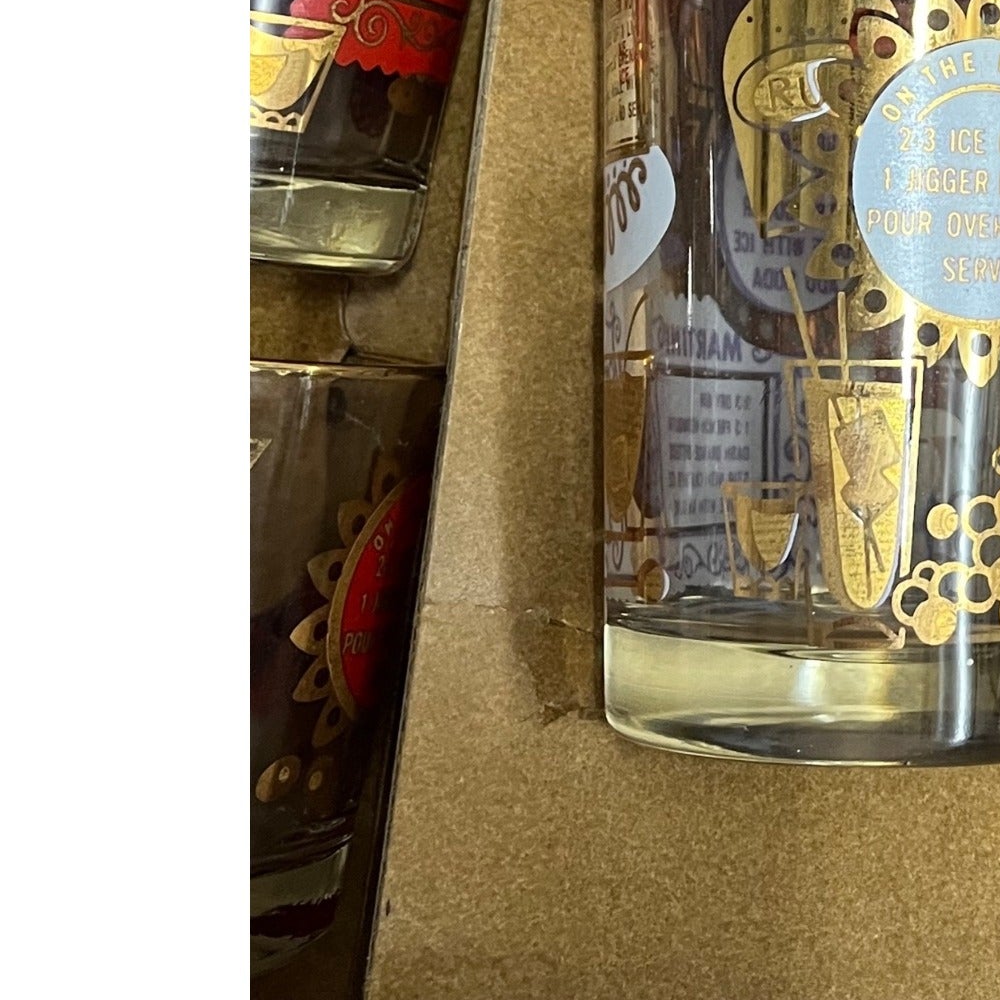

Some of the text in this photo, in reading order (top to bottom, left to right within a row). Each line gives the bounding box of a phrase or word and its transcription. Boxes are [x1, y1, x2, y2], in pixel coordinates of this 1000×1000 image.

[881, 85, 919, 123] ON
[921, 52, 976, 86] THE
[950, 128, 985, 156] ICE
[884, 167, 891, 190] 1
[907, 167, 989, 196] JIGGER
[866, 208, 933, 236] POUR
